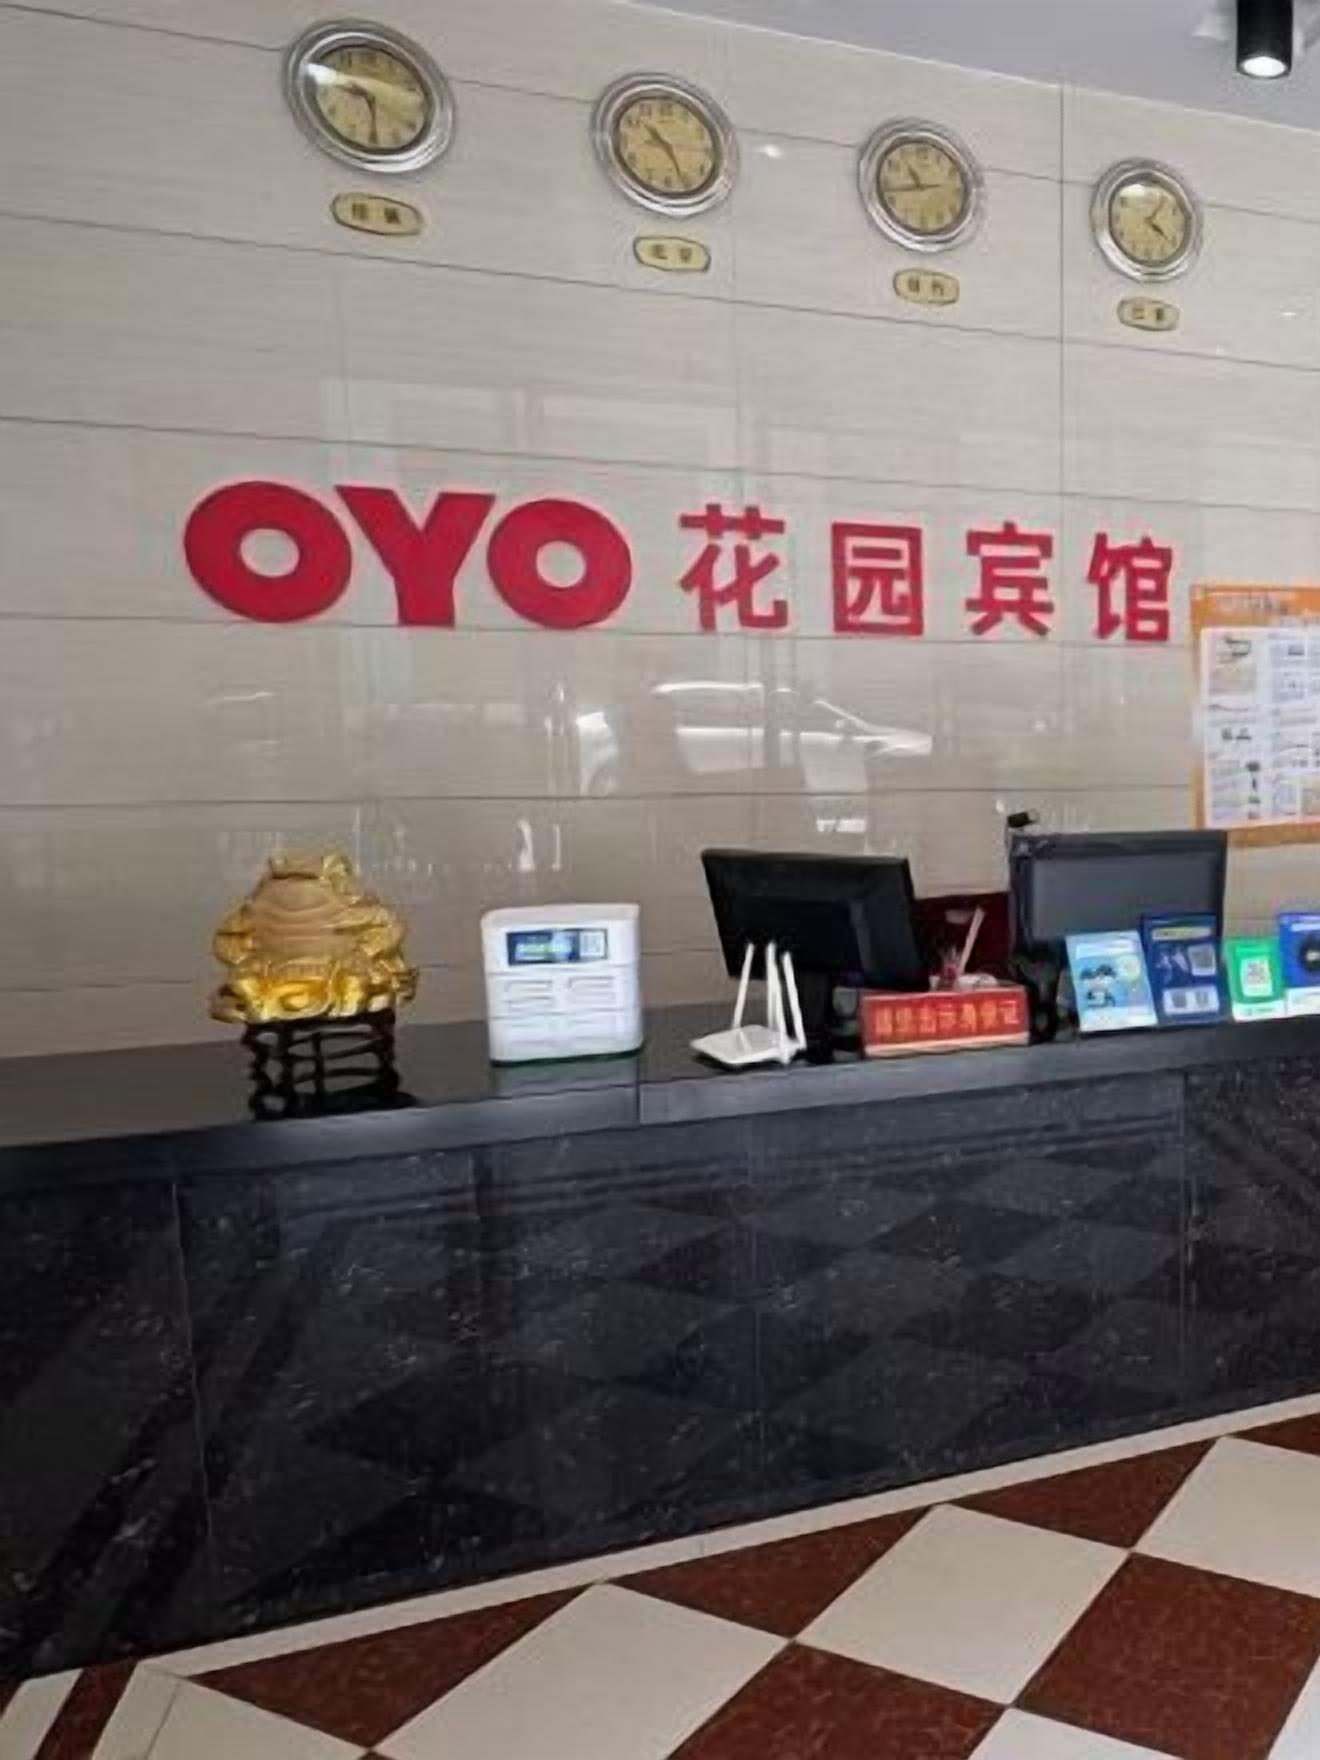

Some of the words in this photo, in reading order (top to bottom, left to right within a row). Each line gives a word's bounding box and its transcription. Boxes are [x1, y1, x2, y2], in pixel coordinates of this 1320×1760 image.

[184, 480, 633, 629] OYO
[680, 502, 1174, 642] 花园宾馆
